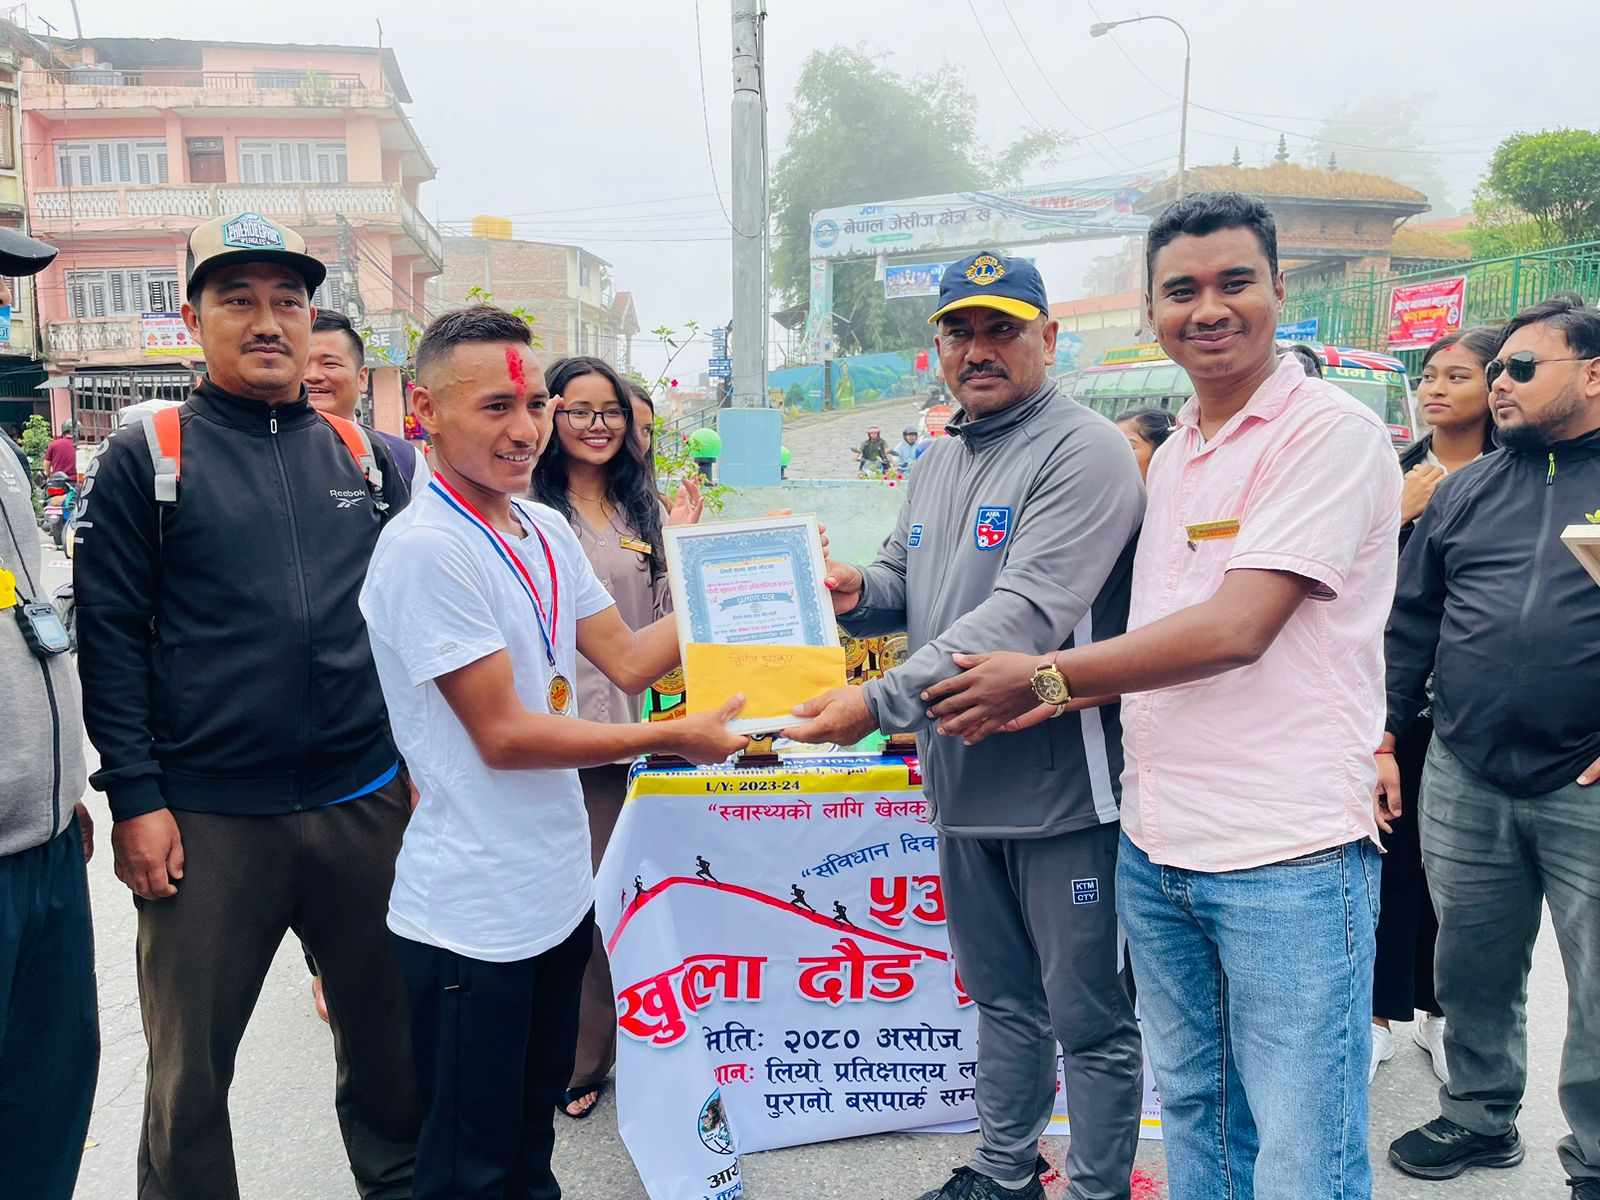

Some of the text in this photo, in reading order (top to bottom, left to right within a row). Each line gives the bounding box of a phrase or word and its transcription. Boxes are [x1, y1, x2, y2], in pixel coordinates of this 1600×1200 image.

[843, 218, 884, 234] नेपाल
[888, 210, 935, 230] जेसीज
[329, 489, 366, 498] Reebok
[705, 780, 801, 793] L/Y: 2023-24
[823, 798, 864, 819] लागि
[875, 797, 929, 823] खेलकु
[900, 835, 938, 854] दिव
[1076, 881, 1095, 890] KTM
[1077, 893, 1095, 902] CTY
[618, 953, 768, 1044] खुला
[798, 938, 922, 1005] दौड
[785, 1029, 860, 1053] २०८०
[877, 1023, 963, 1051] असोज
[765, 1057, 823, 1083] लियो
[833, 1056, 948, 1083] प्रतिक्षालय
[764, 1087, 834, 1119] पुरानो
[845, 1086, 928, 1113] बसपार्क
